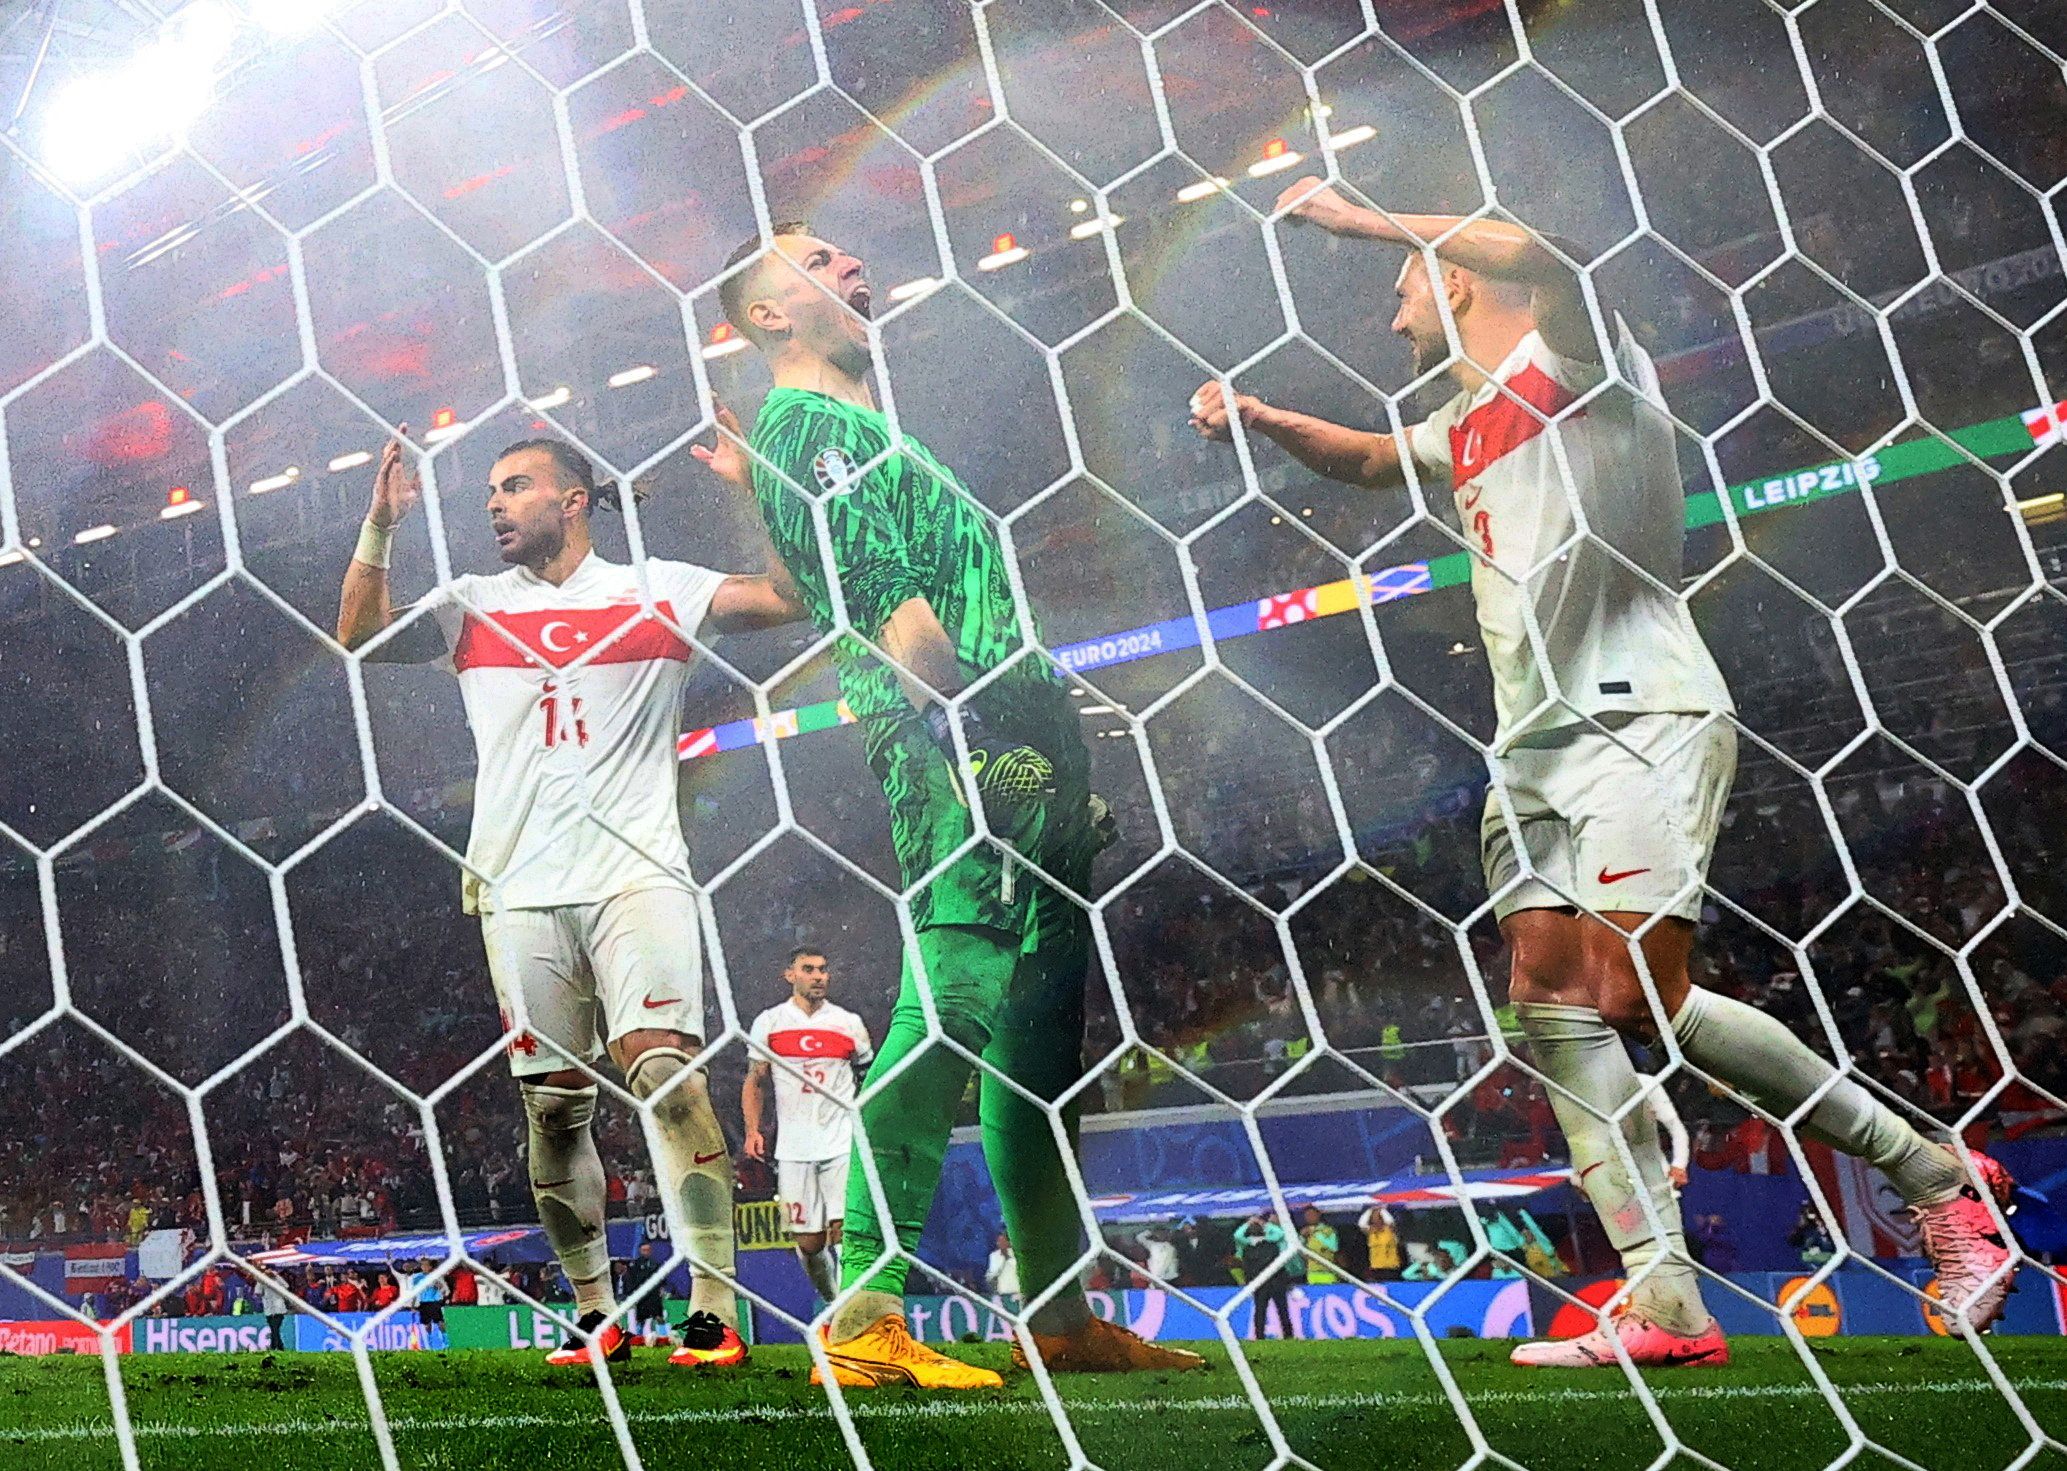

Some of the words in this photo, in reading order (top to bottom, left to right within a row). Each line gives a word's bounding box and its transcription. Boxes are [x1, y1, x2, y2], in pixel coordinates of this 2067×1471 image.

[1744, 457, 1882, 510] LEIPZIG
[1474, 511, 1494, 568] 3
[1060, 630, 1162, 670] EURO2024
[146, 1318, 271, 1353] Hisense
